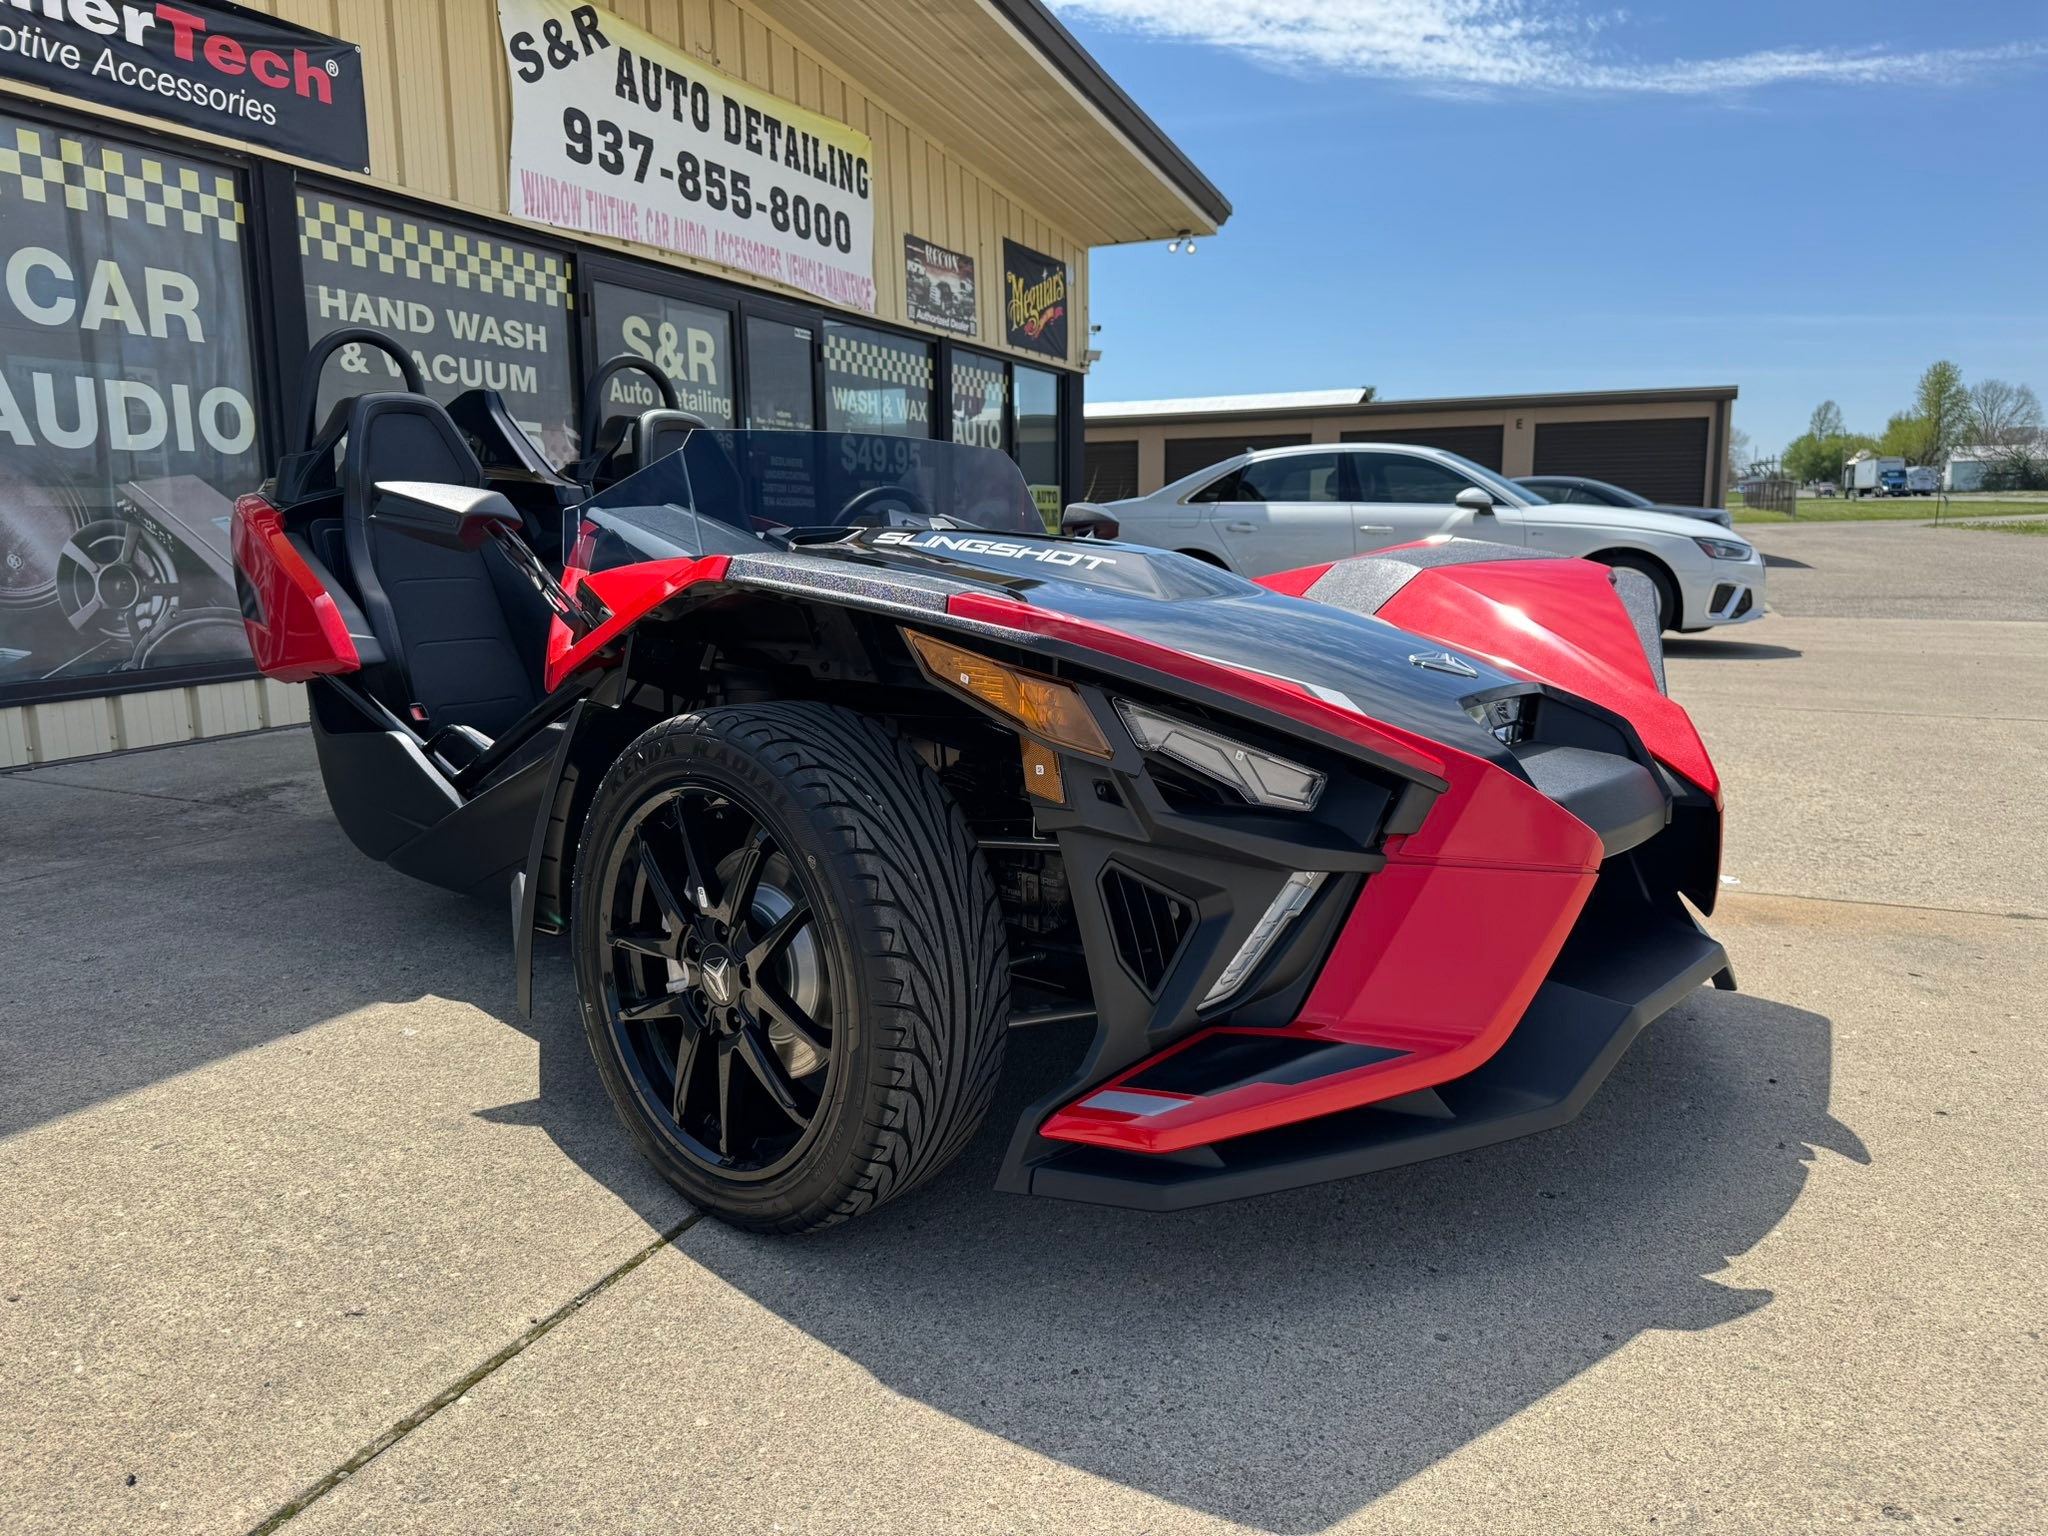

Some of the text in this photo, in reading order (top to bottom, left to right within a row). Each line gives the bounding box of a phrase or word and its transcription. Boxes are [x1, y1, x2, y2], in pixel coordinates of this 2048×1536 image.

[92, 48, 277, 126] Accessories
[509, 4, 869, 199] S&R AUTO DETAILING
[563, 107, 851, 254] 937-855-8000
[520, 168, 582, 228] WINDOW
[646, 207, 670, 248] CAR
[786, 251, 825, 296] VEHICLE
[5, 246, 205, 343] CAR
[318, 285, 547, 352] HAND WASH
[1006, 266, 1064, 336] Meguiar's
[340, 342, 538, 394] & VACUUM
[622, 315, 717, 385] S&R
[610, 377, 653, 405] Auto
[832, 386, 928, 423] WASH & WAX
[952, 419, 1001, 450] AUTO
[1516, 419, 1523, 430] E
[841, 434, 922, 475] $49.95
[1036, 490, 1058, 504] AUTO
[873, 531, 1117, 571] SLINGSHOT
